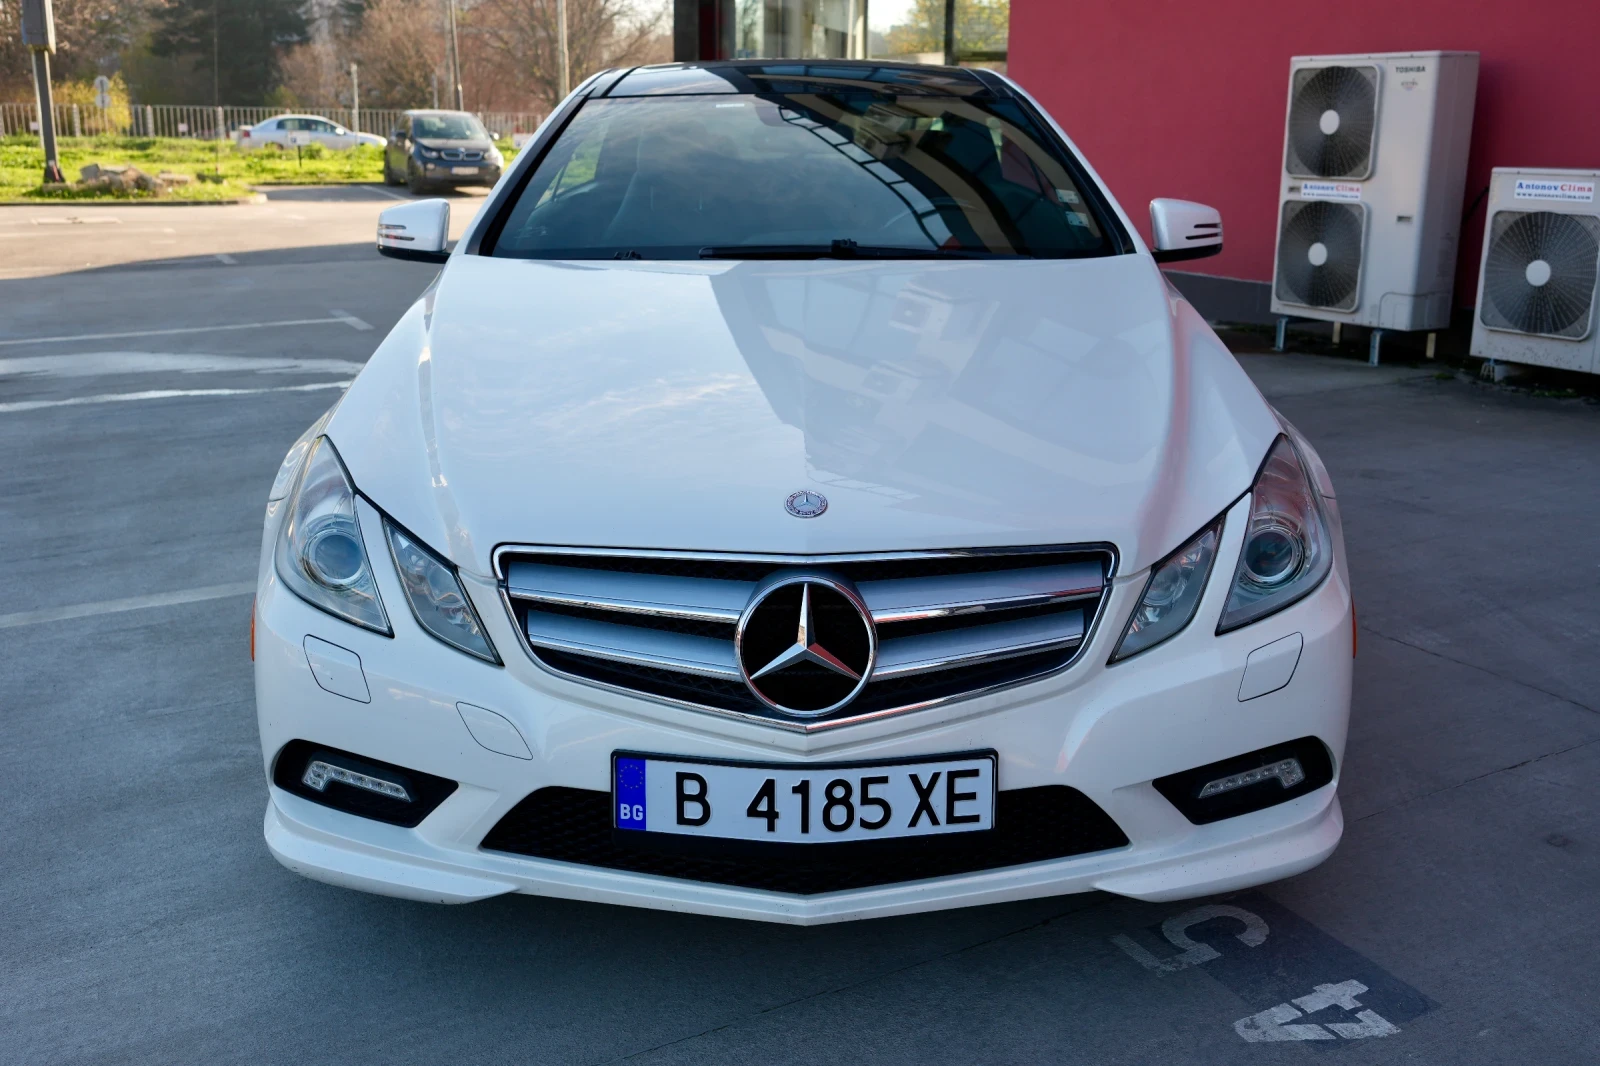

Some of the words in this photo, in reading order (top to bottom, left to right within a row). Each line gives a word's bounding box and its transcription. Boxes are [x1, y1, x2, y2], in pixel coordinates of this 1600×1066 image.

[1517, 182, 1559, 191] Antonov
[1560, 184, 1593, 193] Clima
[675, 771, 712, 827] B
[746, 775, 892, 834] 4185
[907, 768, 980, 829] XE
[619, 803, 644, 821] BG
